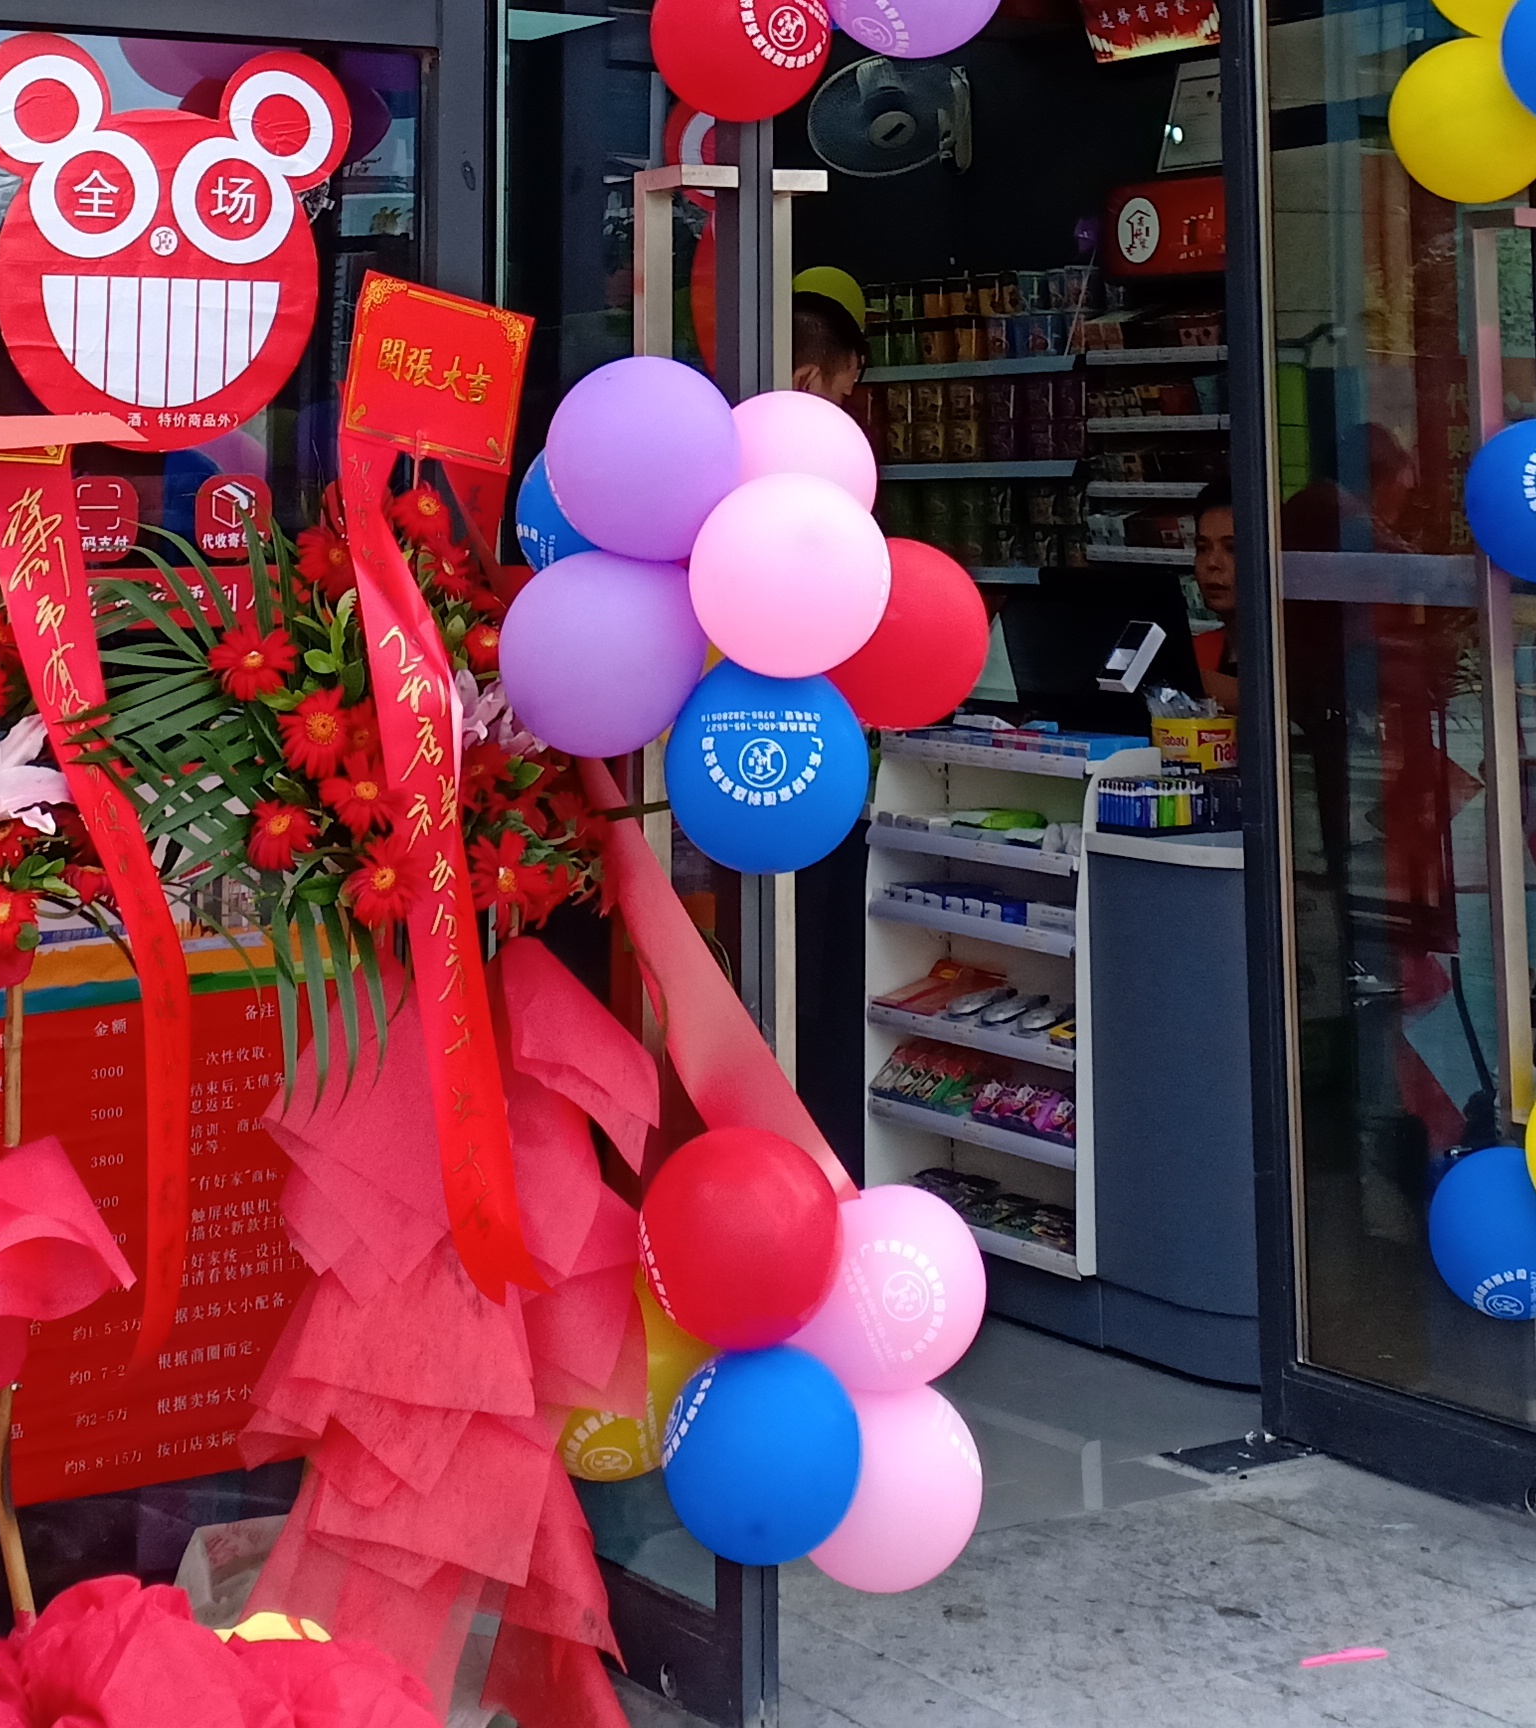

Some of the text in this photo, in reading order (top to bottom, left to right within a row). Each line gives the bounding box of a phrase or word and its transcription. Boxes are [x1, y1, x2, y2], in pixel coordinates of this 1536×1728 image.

[72, 170, 256, 226] 全 场
[377, 337, 494, 405] 開張大吉
[244, 1001, 276, 1021] 备注
[93, 1018, 128, 1038] 金额
[91, 1065, 125, 1080] 3000
[90, 1106, 124, 1121] 5000
[90, 1153, 125, 1169] 3800
